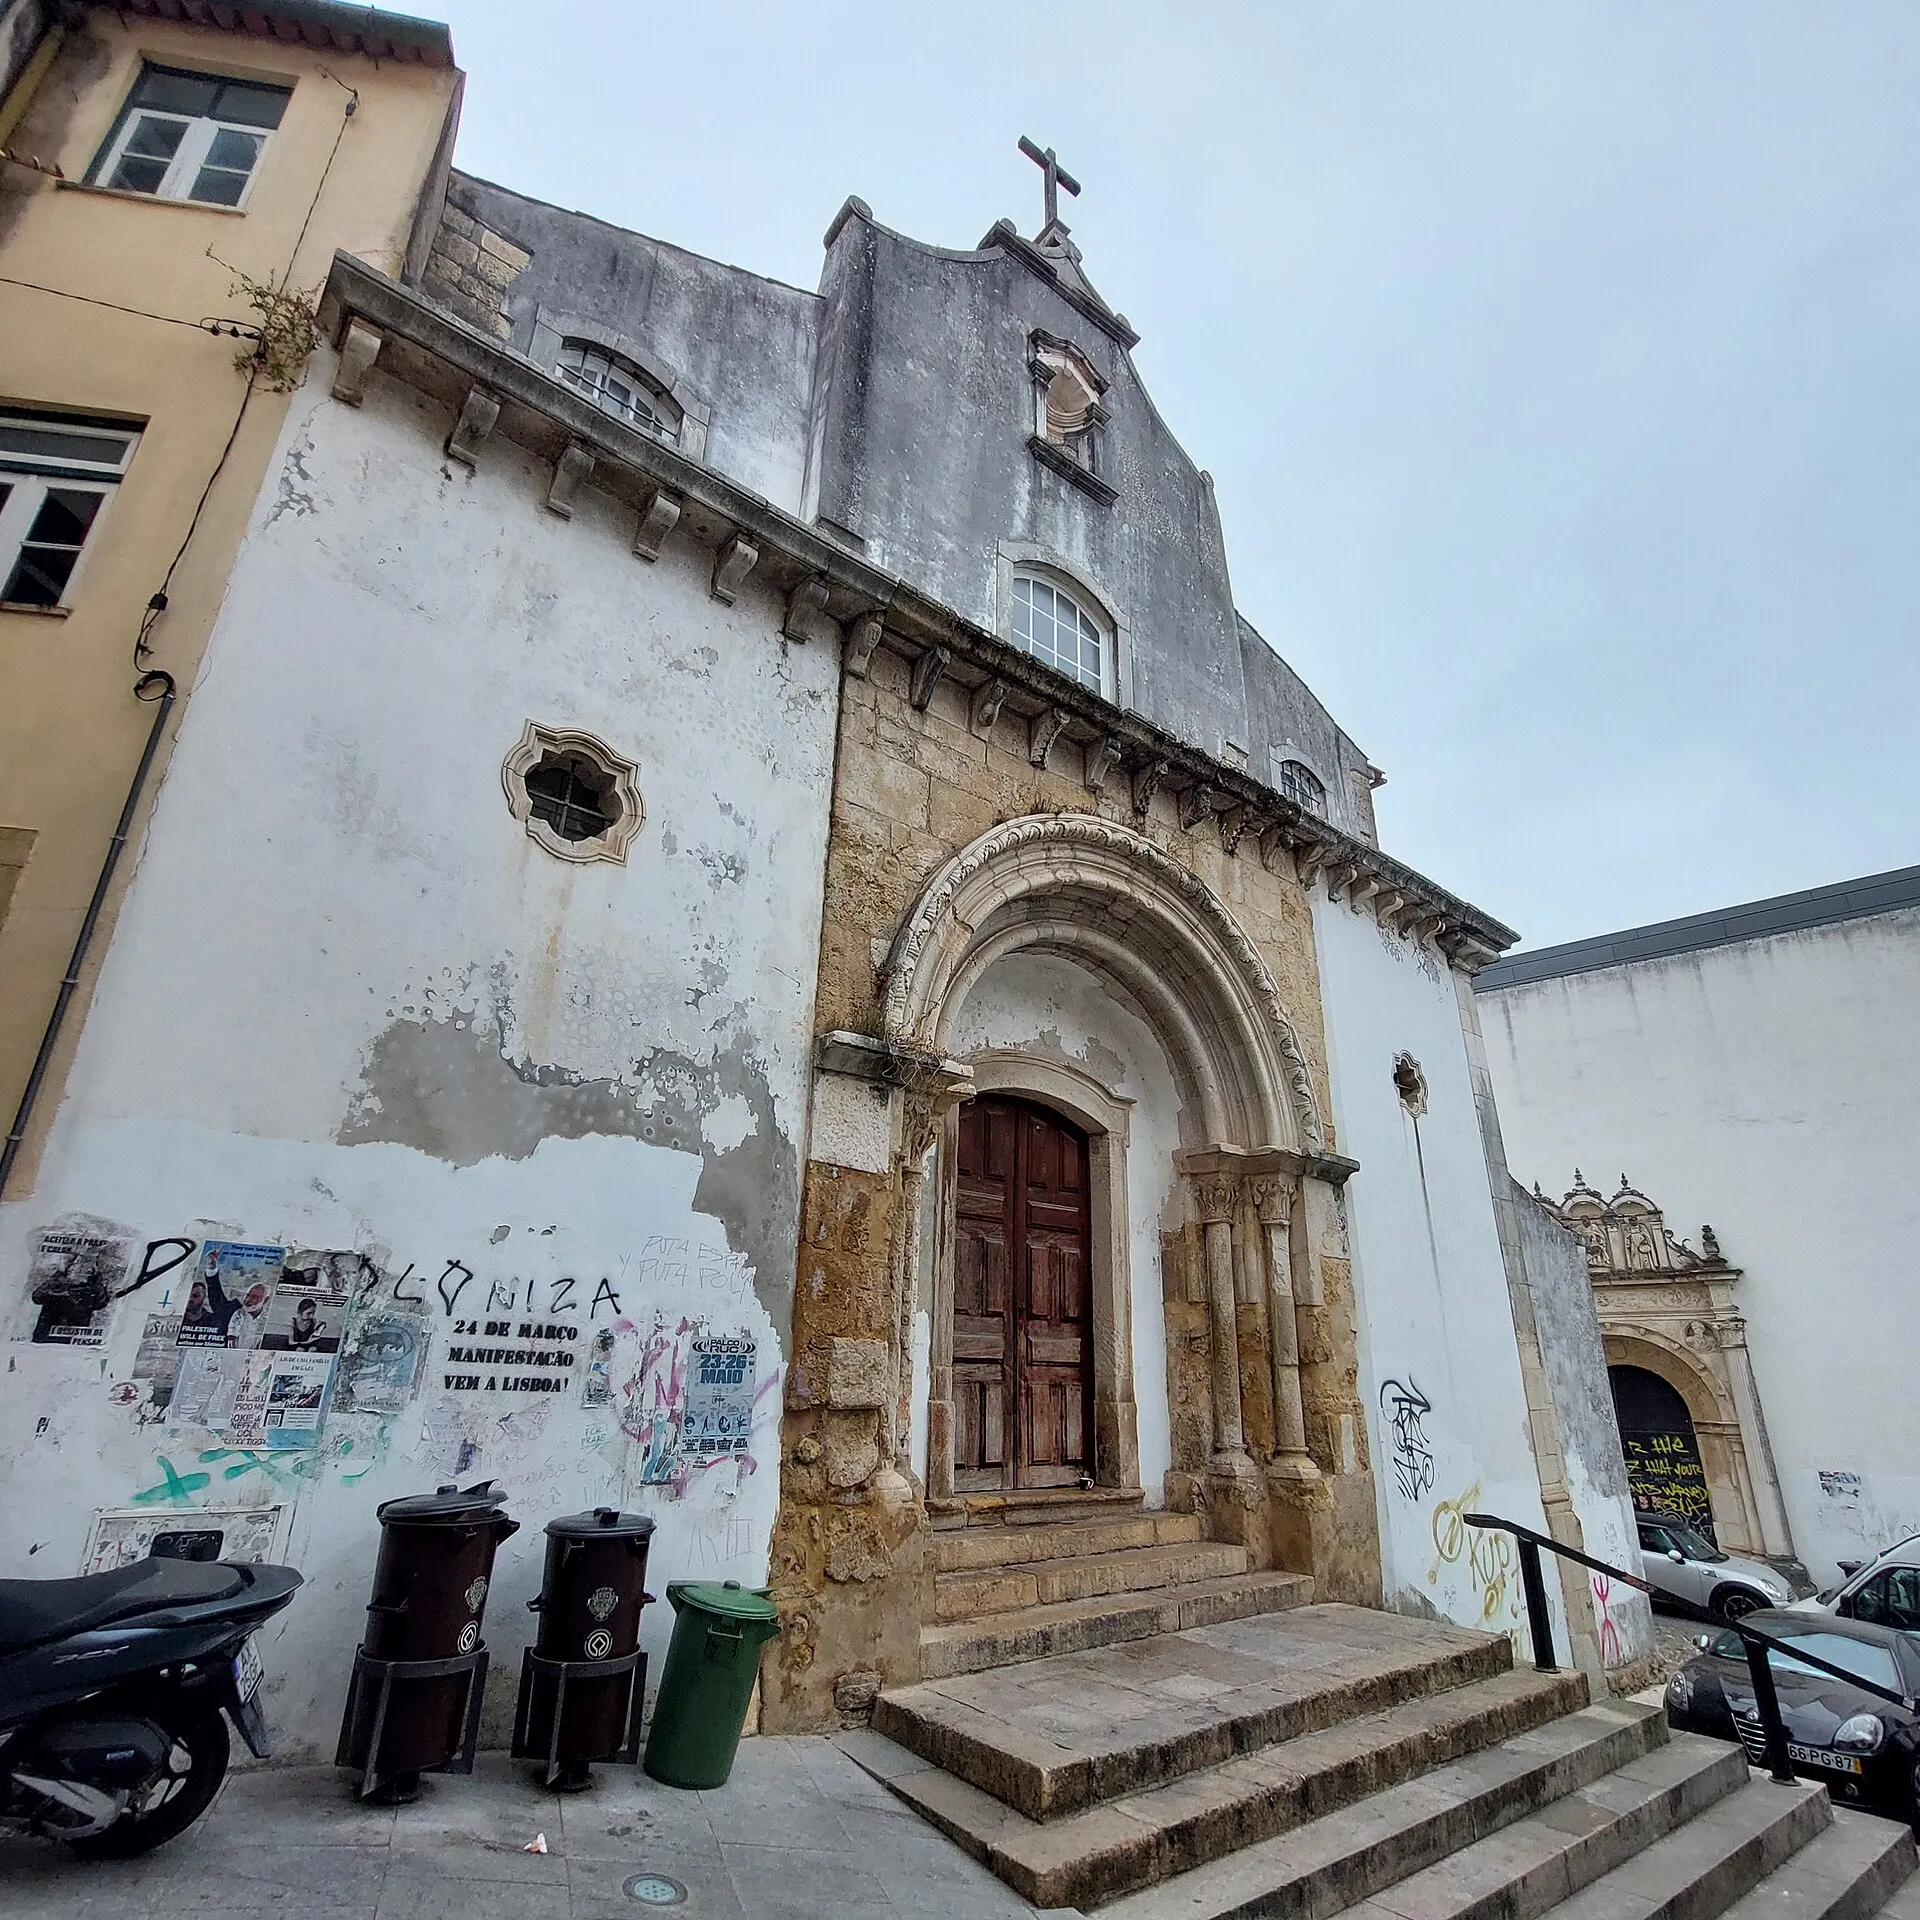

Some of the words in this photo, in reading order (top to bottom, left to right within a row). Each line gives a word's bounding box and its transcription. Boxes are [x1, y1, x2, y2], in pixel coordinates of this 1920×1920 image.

[181, 1325, 220, 1334] PALESTINE
[453, 1319, 478, 1336] 24
[484, 1321, 512, 1337] DE
[517, 1323, 579, 1344] MARÇO
[208, 1334, 227, 1342] FREE
[709, 1345, 740, 1354] RUC
[699, 1354, 747, 1369] 23-26
[444, 1375, 481, 1391] VEM
[484, 1376, 497, 1391] A
[501, 1376, 570, 1393] LISBOA!
[699, 1369, 744, 1384] MAIO
